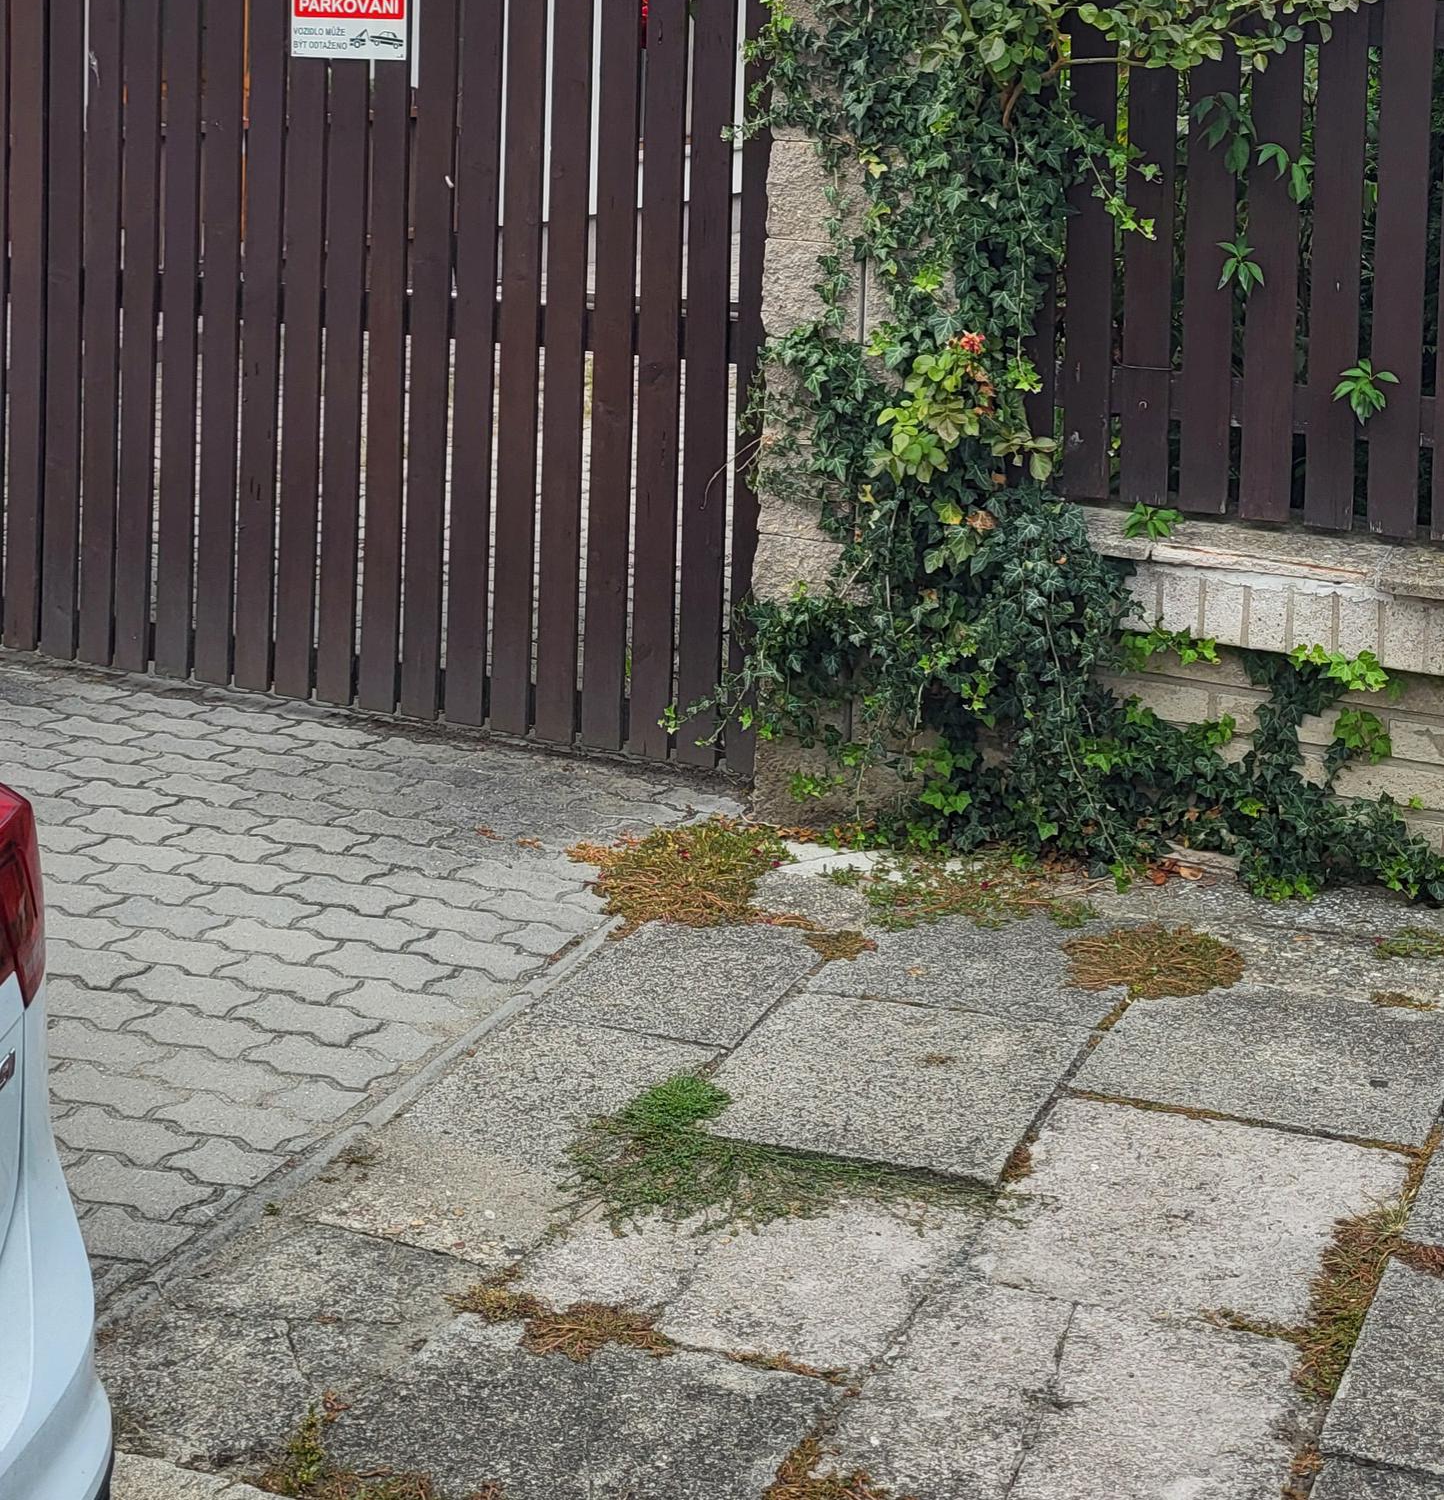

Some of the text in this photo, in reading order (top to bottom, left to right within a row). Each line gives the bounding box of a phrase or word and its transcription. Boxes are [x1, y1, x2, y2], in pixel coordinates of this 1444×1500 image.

[293, 26, 346, 37] VOZIDLO MŮŽE
[293, 39, 348, 50] BÝT ODTAŽENO
